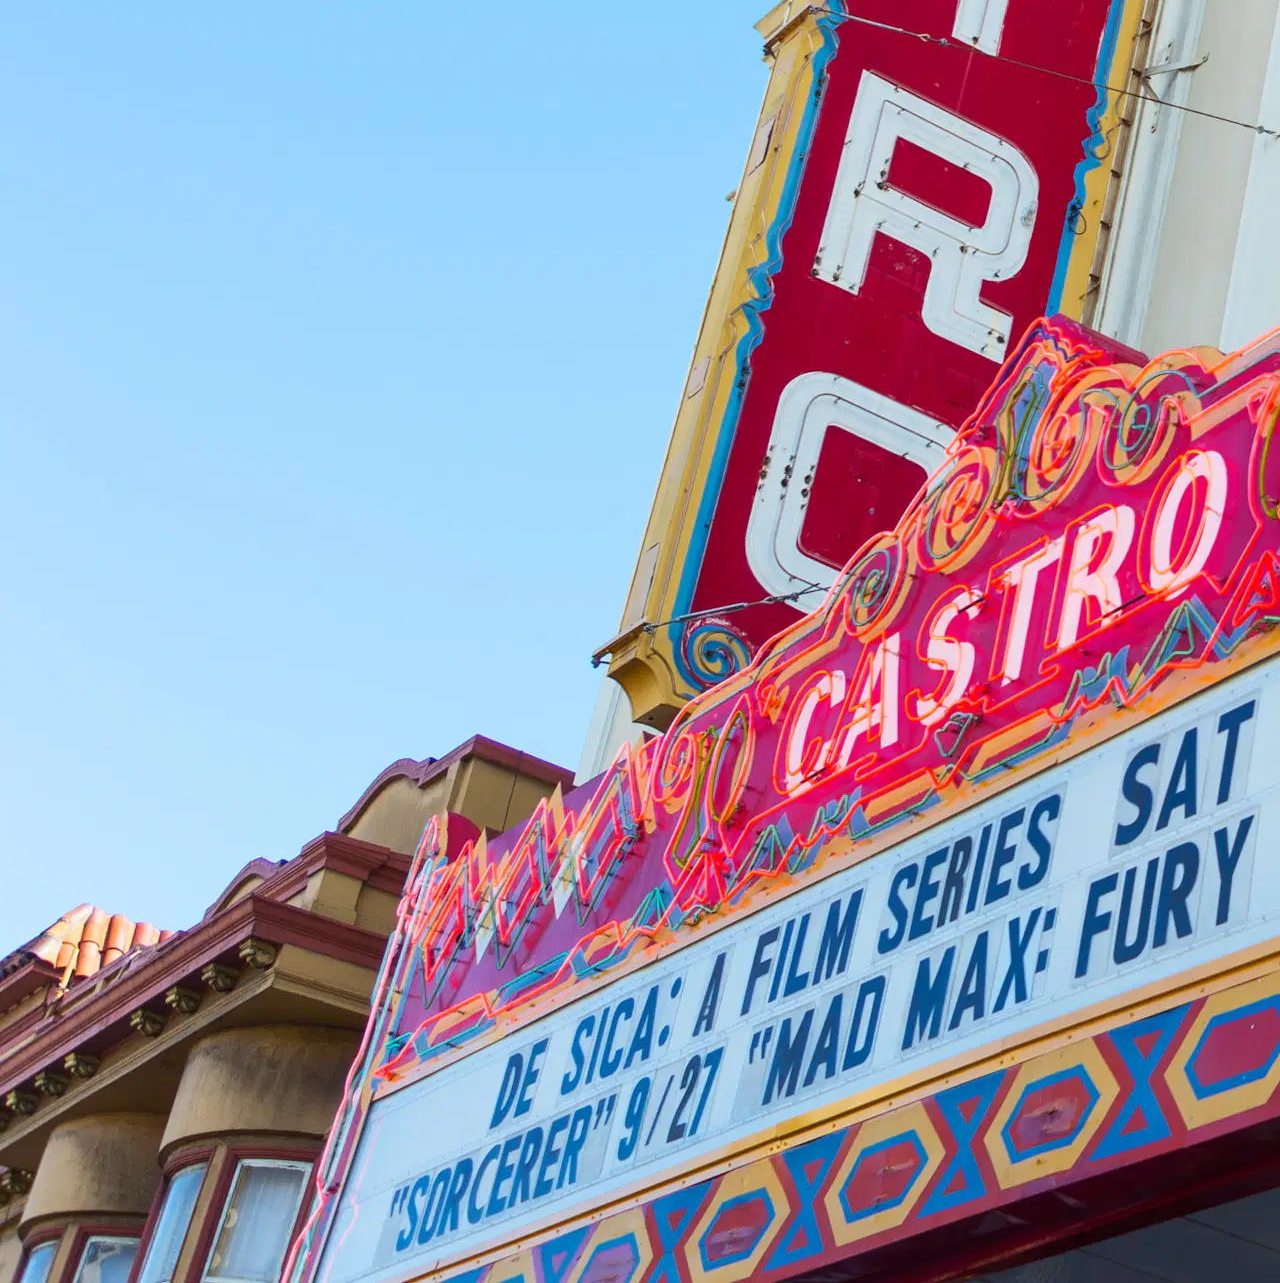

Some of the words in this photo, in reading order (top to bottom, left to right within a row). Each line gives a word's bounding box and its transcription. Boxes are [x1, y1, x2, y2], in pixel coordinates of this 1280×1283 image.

[773, 449, 1228, 797] CASTRO
[390, 1094, 615, 1252] "SORCERER"
[617, 1046, 724, 1161] 9/27
[749, 975, 886, 1106] "MAD
[901, 906, 1057, 1051] MAX:
[1074, 815, 1255, 979] FURY
[489, 1038, 549, 1130] DE
[560, 973, 682, 1096] SICA:
[692, 952, 727, 1037] A
[740, 888, 864, 1016] FILM
[877, 794, 1061, 954] SERIES
[1114, 699, 1256, 846] SAT
